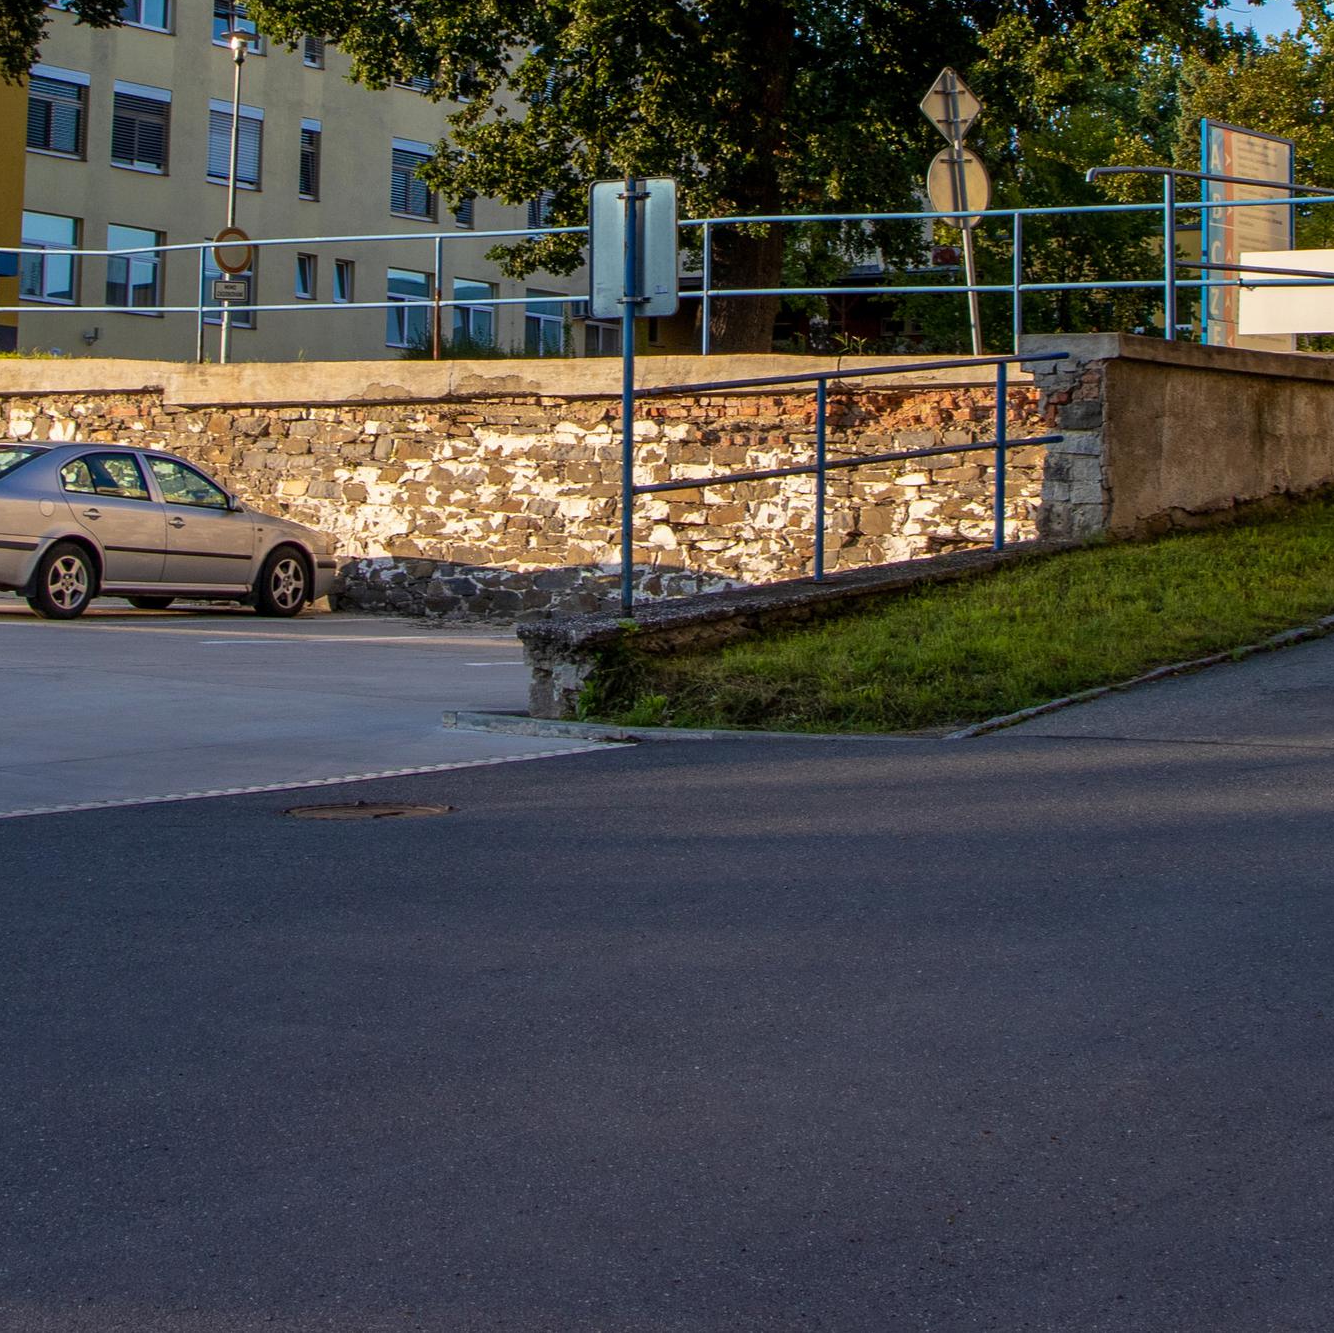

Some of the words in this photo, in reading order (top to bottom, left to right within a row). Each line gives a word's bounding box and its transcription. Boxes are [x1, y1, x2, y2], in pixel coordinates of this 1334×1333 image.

[1211, 144, 1221, 170] A
[1212, 193, 1222, 219] B
[1211, 241, 1221, 264] C
[1210, 288, 1220, 315] Z
